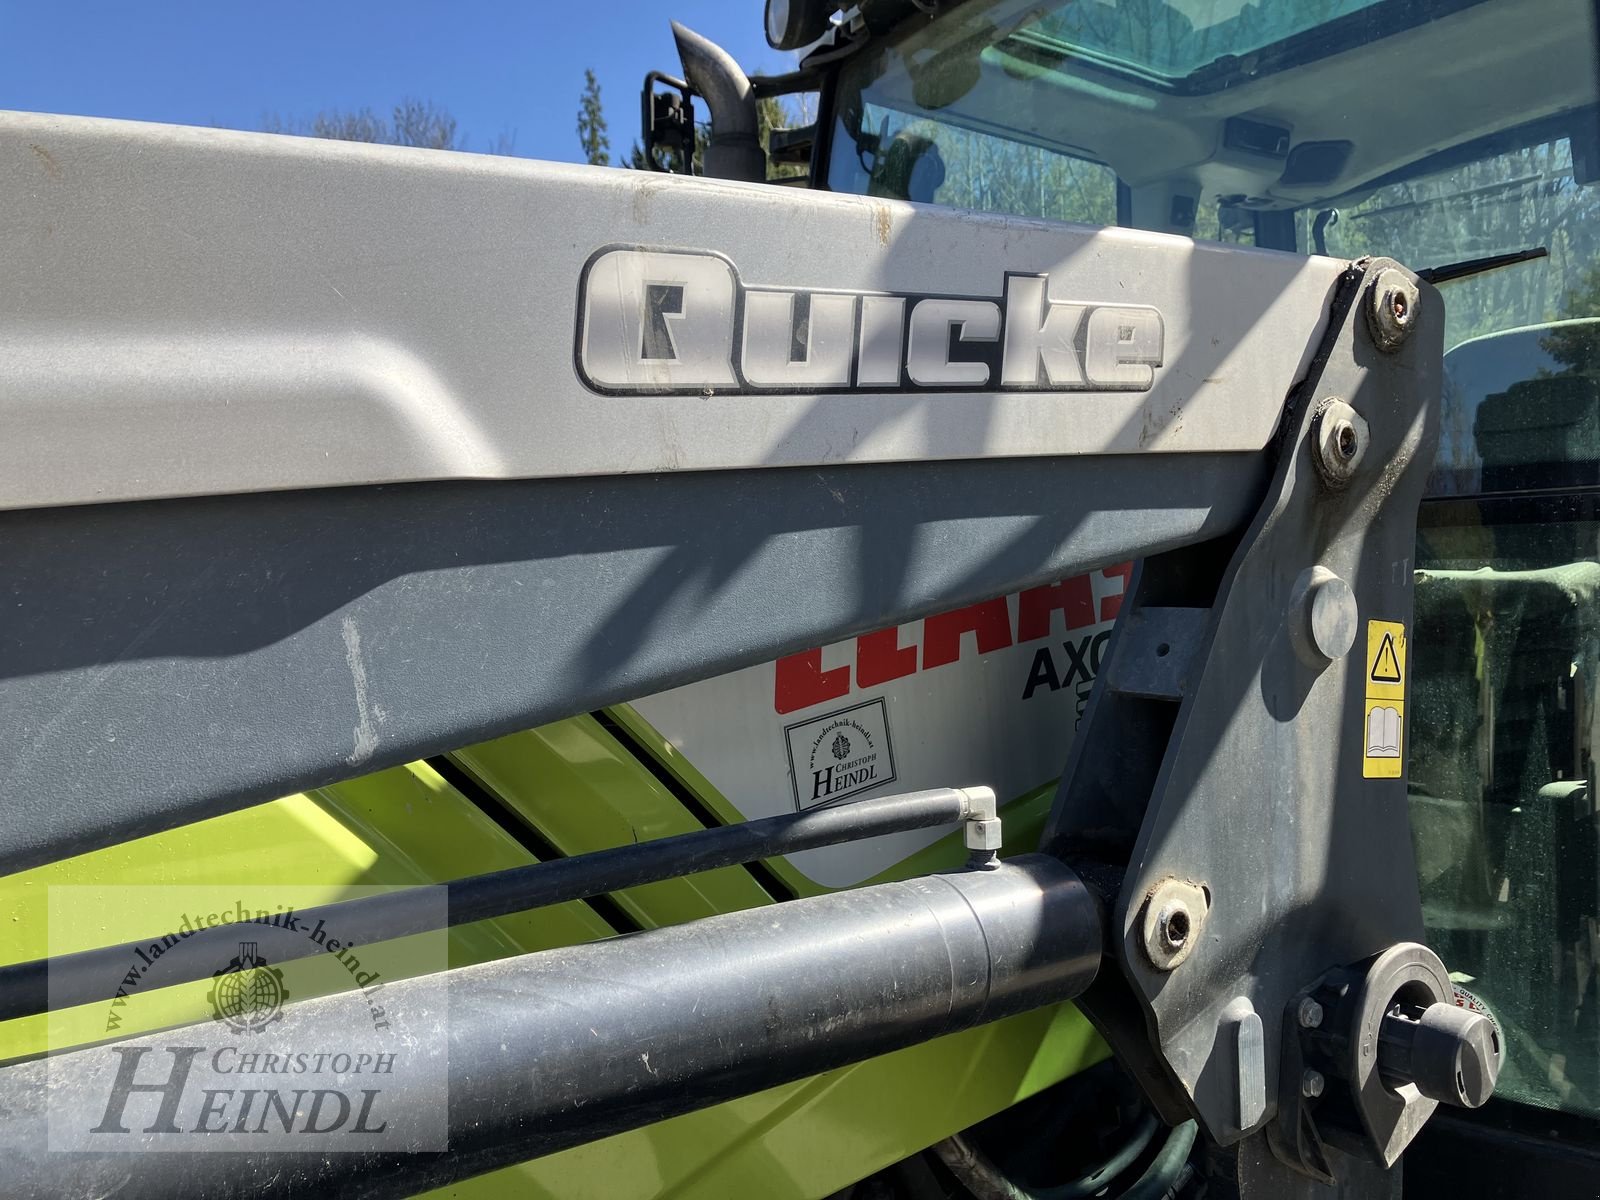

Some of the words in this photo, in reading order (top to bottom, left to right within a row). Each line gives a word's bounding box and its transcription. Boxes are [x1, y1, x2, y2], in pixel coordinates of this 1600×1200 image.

[574, 244, 1165, 395] Quicke
[810, 719, 874, 769] www.landtechnik-heindl.at
[811, 764, 877, 800] HEINDL
[1460, 989, 1487, 1010] QUALITY
